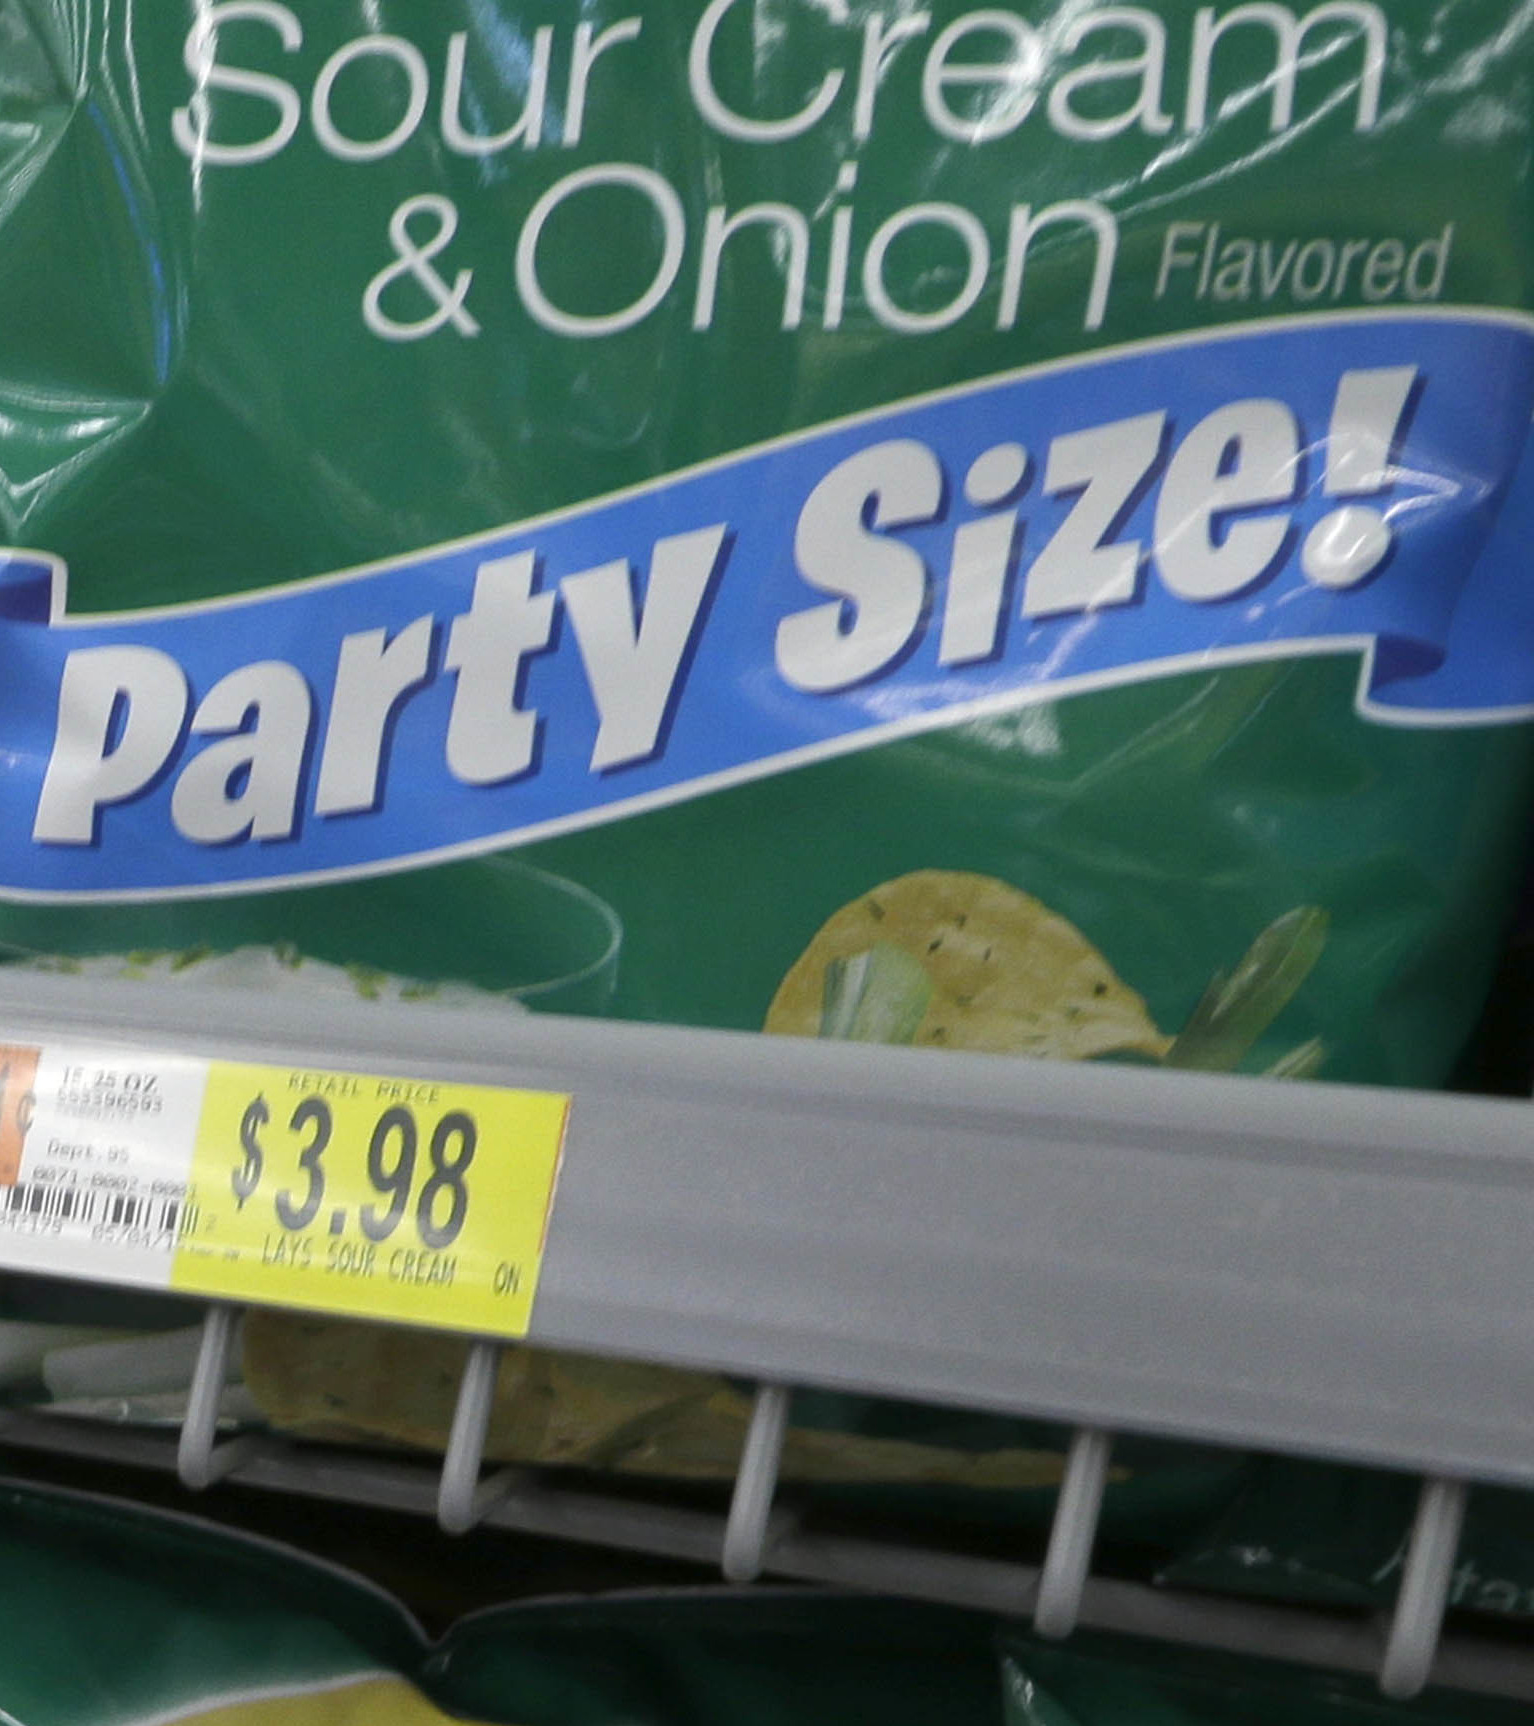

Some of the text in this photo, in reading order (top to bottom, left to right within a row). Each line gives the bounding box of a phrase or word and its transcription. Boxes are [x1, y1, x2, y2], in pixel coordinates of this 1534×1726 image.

[170, 0, 1387, 167] Sour Cream
[360, 159, 1456, 343] & Onion Flavored
[31, 363, 1419, 849] Party Size!
[288, 1073, 440, 1103] RETAIL PRICE
[231, 1090, 478, 1250] $3.98
[261, 1233, 312, 1266] LAYS
[327, 1241, 377, 1278] SOUR
[388, 1250, 457, 1288] CREAM
[492, 1262, 521, 1296] ON
